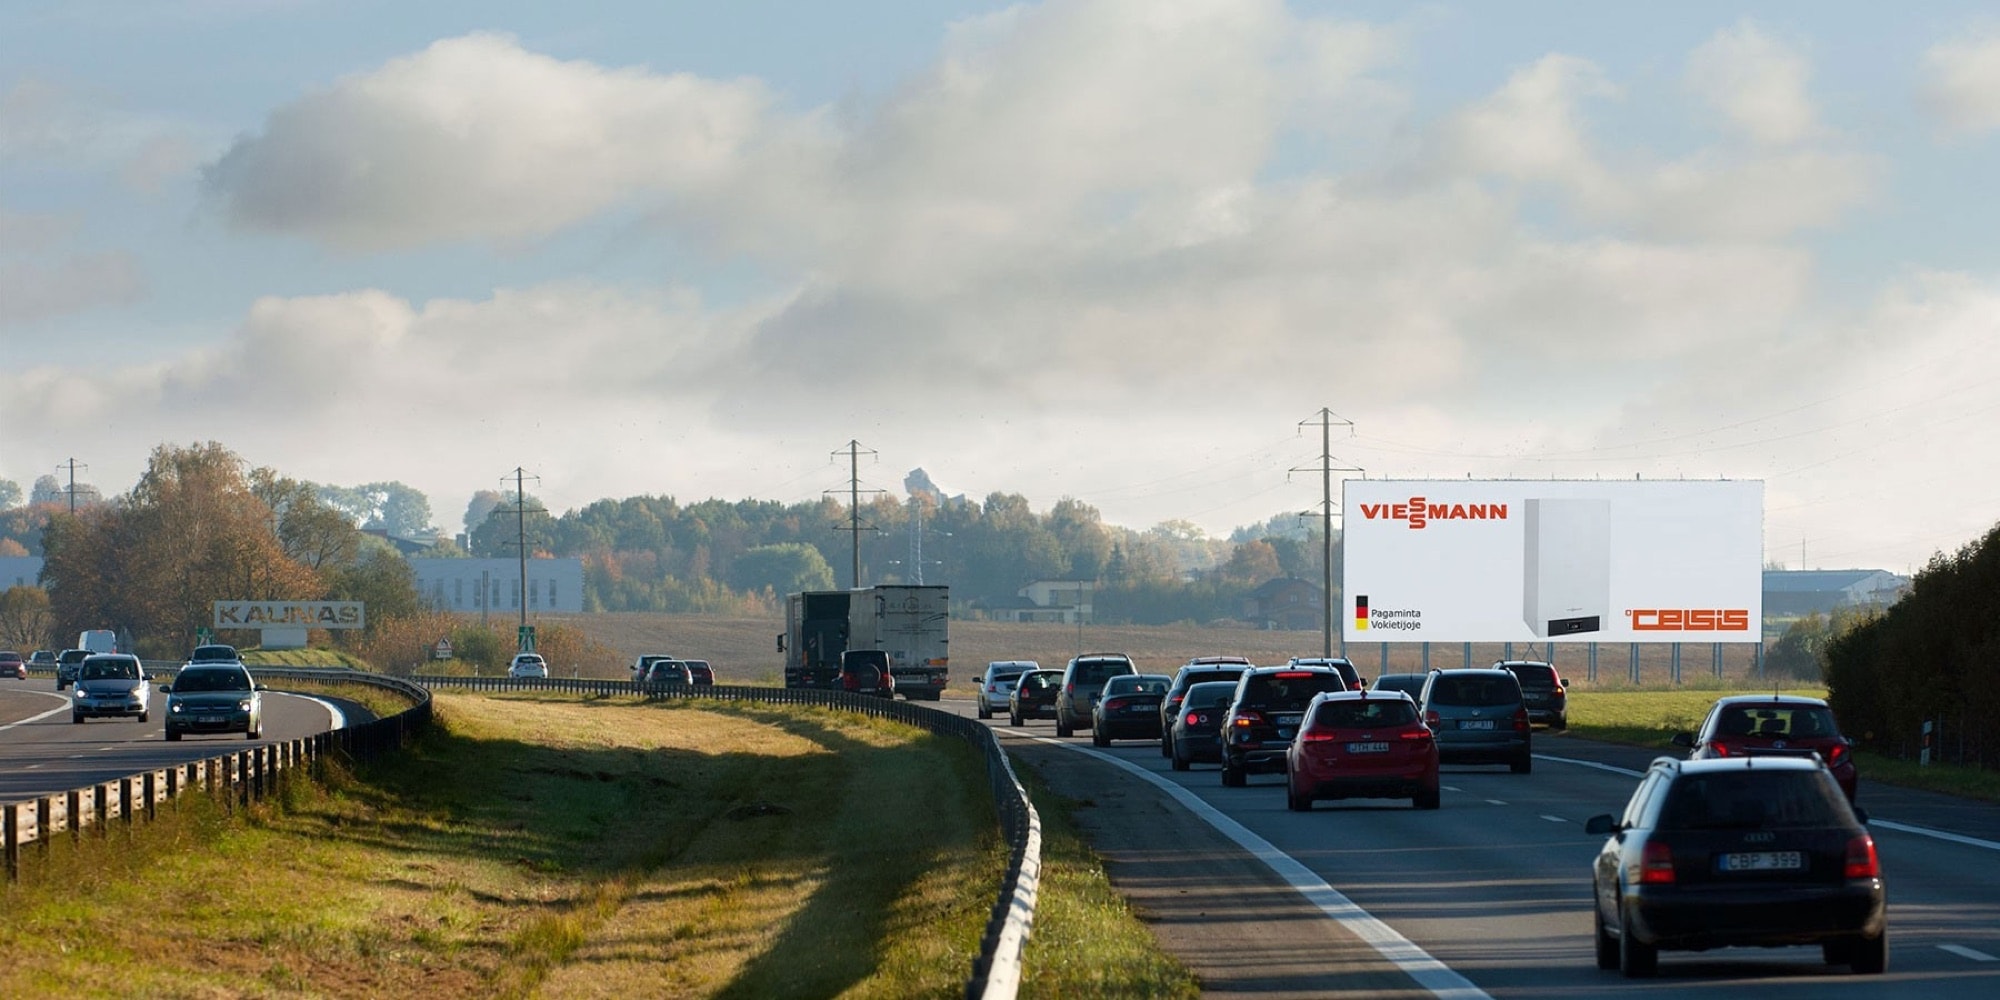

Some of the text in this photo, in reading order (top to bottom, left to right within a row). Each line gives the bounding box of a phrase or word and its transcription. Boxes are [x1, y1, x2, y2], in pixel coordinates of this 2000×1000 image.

[1360, 497, 1507, 529] VIESSMANN
[219, 606, 359, 624] KAUNAS
[1371, 609, 1421, 619] Pagaminta
[1371, 620, 1421, 631] Vokietijoje
[1728, 852, 1799, 869] CBP 399
